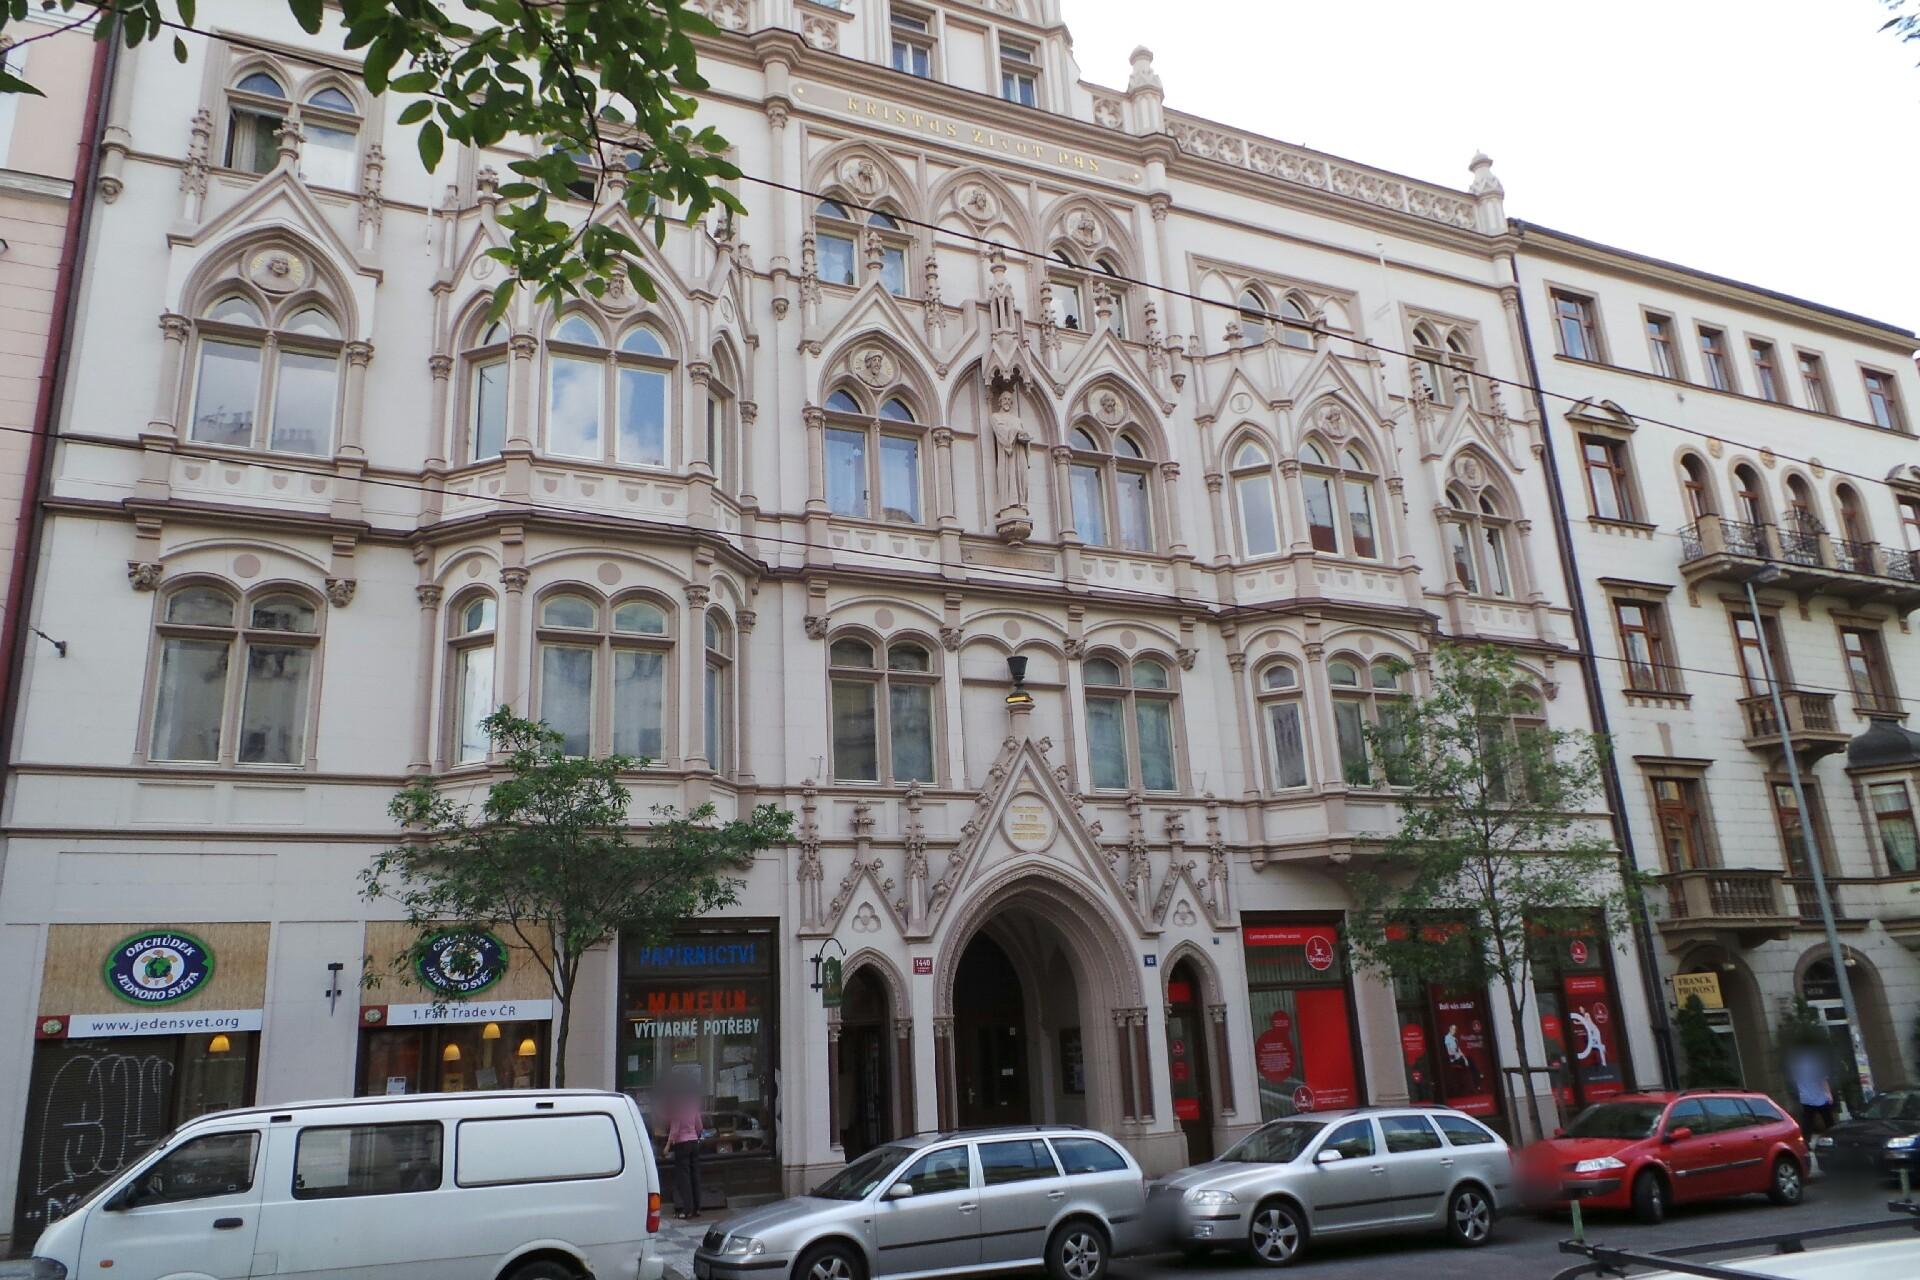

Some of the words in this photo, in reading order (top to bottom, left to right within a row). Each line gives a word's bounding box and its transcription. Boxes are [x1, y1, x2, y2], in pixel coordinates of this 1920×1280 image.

[126, 935, 196, 957] OBCHŮDEK
[117, 973, 166, 1000] JEDNOHO
[167, 972, 199, 998] SVĚTA
[1678, 976, 1713, 986] FRANCK
[1678, 985, 1716, 995] PROVOST
[452, 1006, 487, 1019] Trade
[500, 1004, 516, 1016] ČR
[92, 1017, 239, 1032] www.jedensvet.org
[634, 1018, 698, 1038] VÝTVARNÉ
[704, 1016, 760, 1036] POTŘEBY
